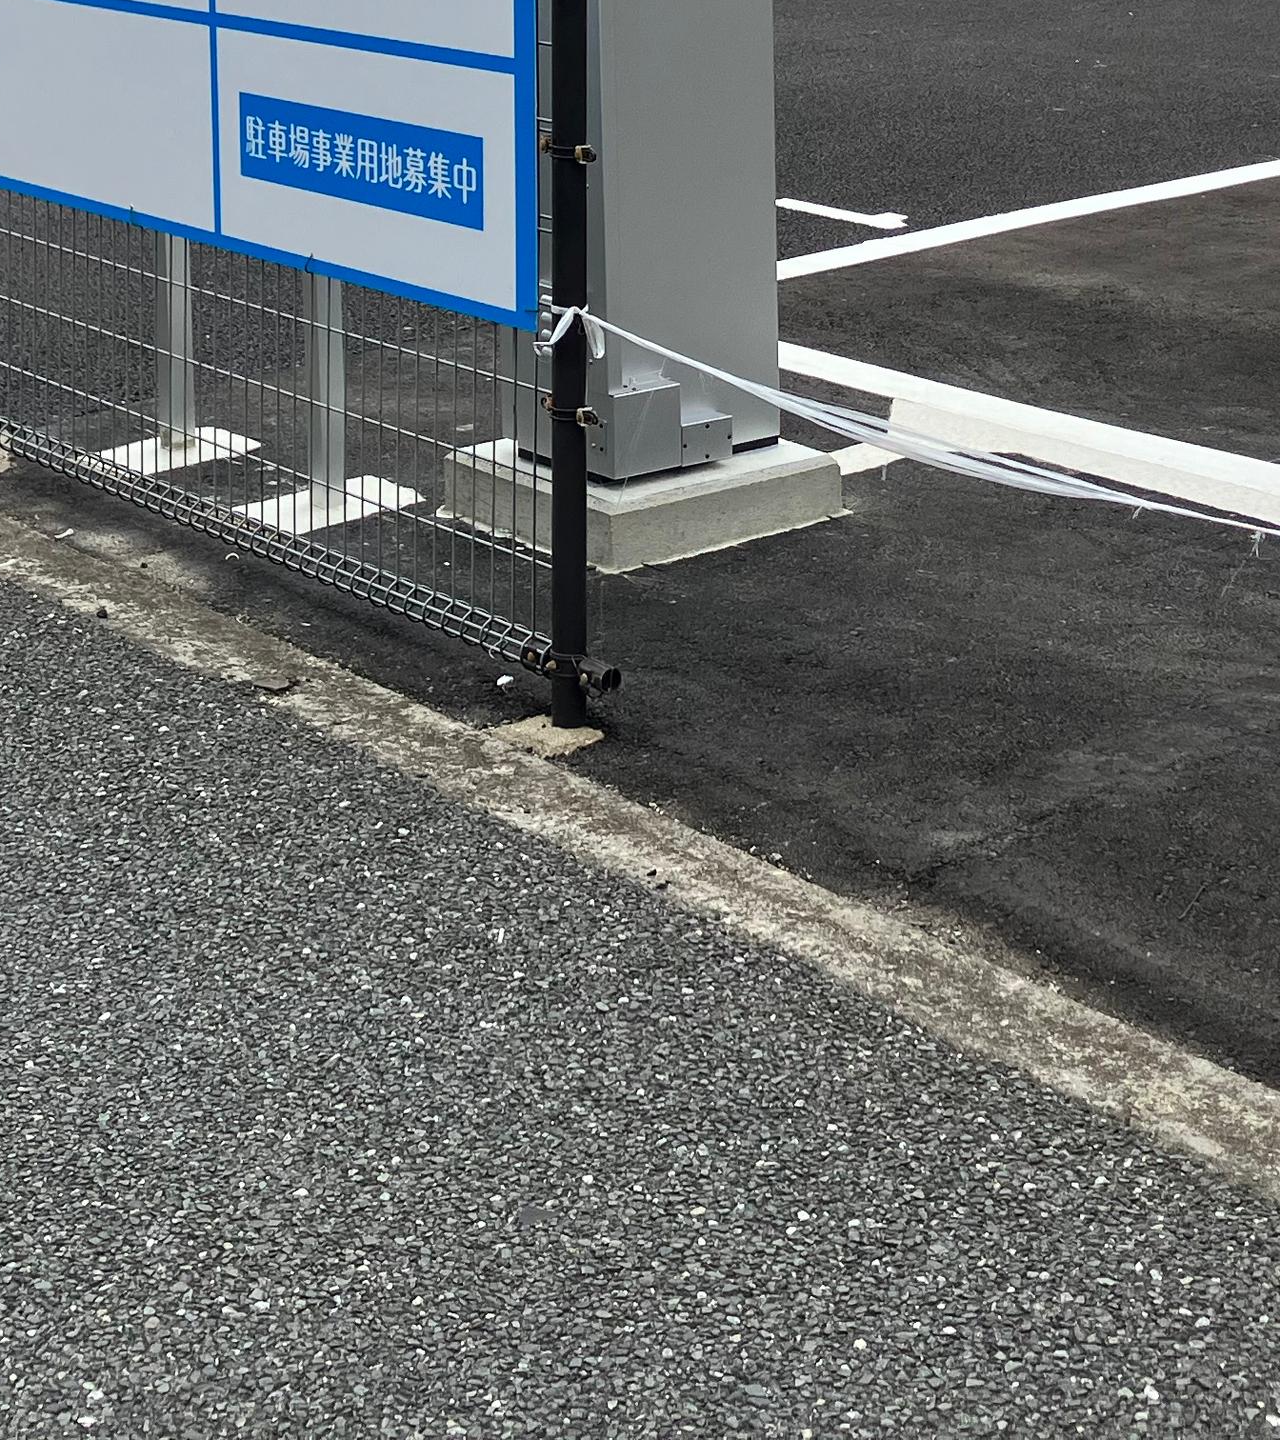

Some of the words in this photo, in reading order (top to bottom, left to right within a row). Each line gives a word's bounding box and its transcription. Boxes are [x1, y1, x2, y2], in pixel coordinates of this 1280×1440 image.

[246, 114, 478, 204] 駐車場事業用地募集中
